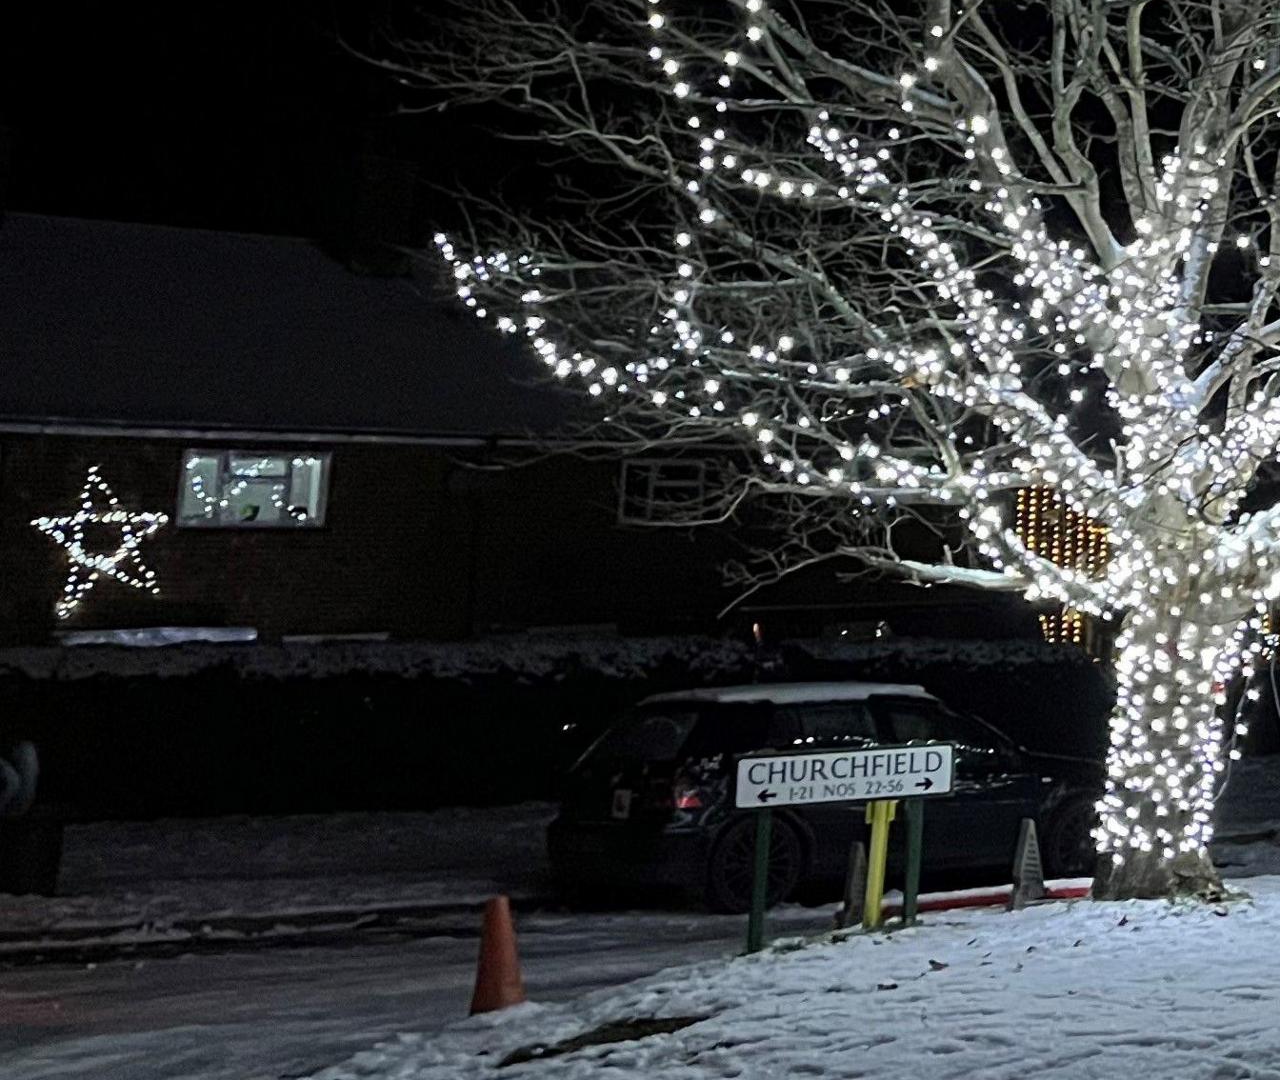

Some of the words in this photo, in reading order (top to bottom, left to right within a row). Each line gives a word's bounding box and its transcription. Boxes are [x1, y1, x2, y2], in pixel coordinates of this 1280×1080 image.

[748, 751, 943, 785] CHURCHFIELD
[823, 783, 856, 797] NOS
[865, 779, 904, 795] 22-56
